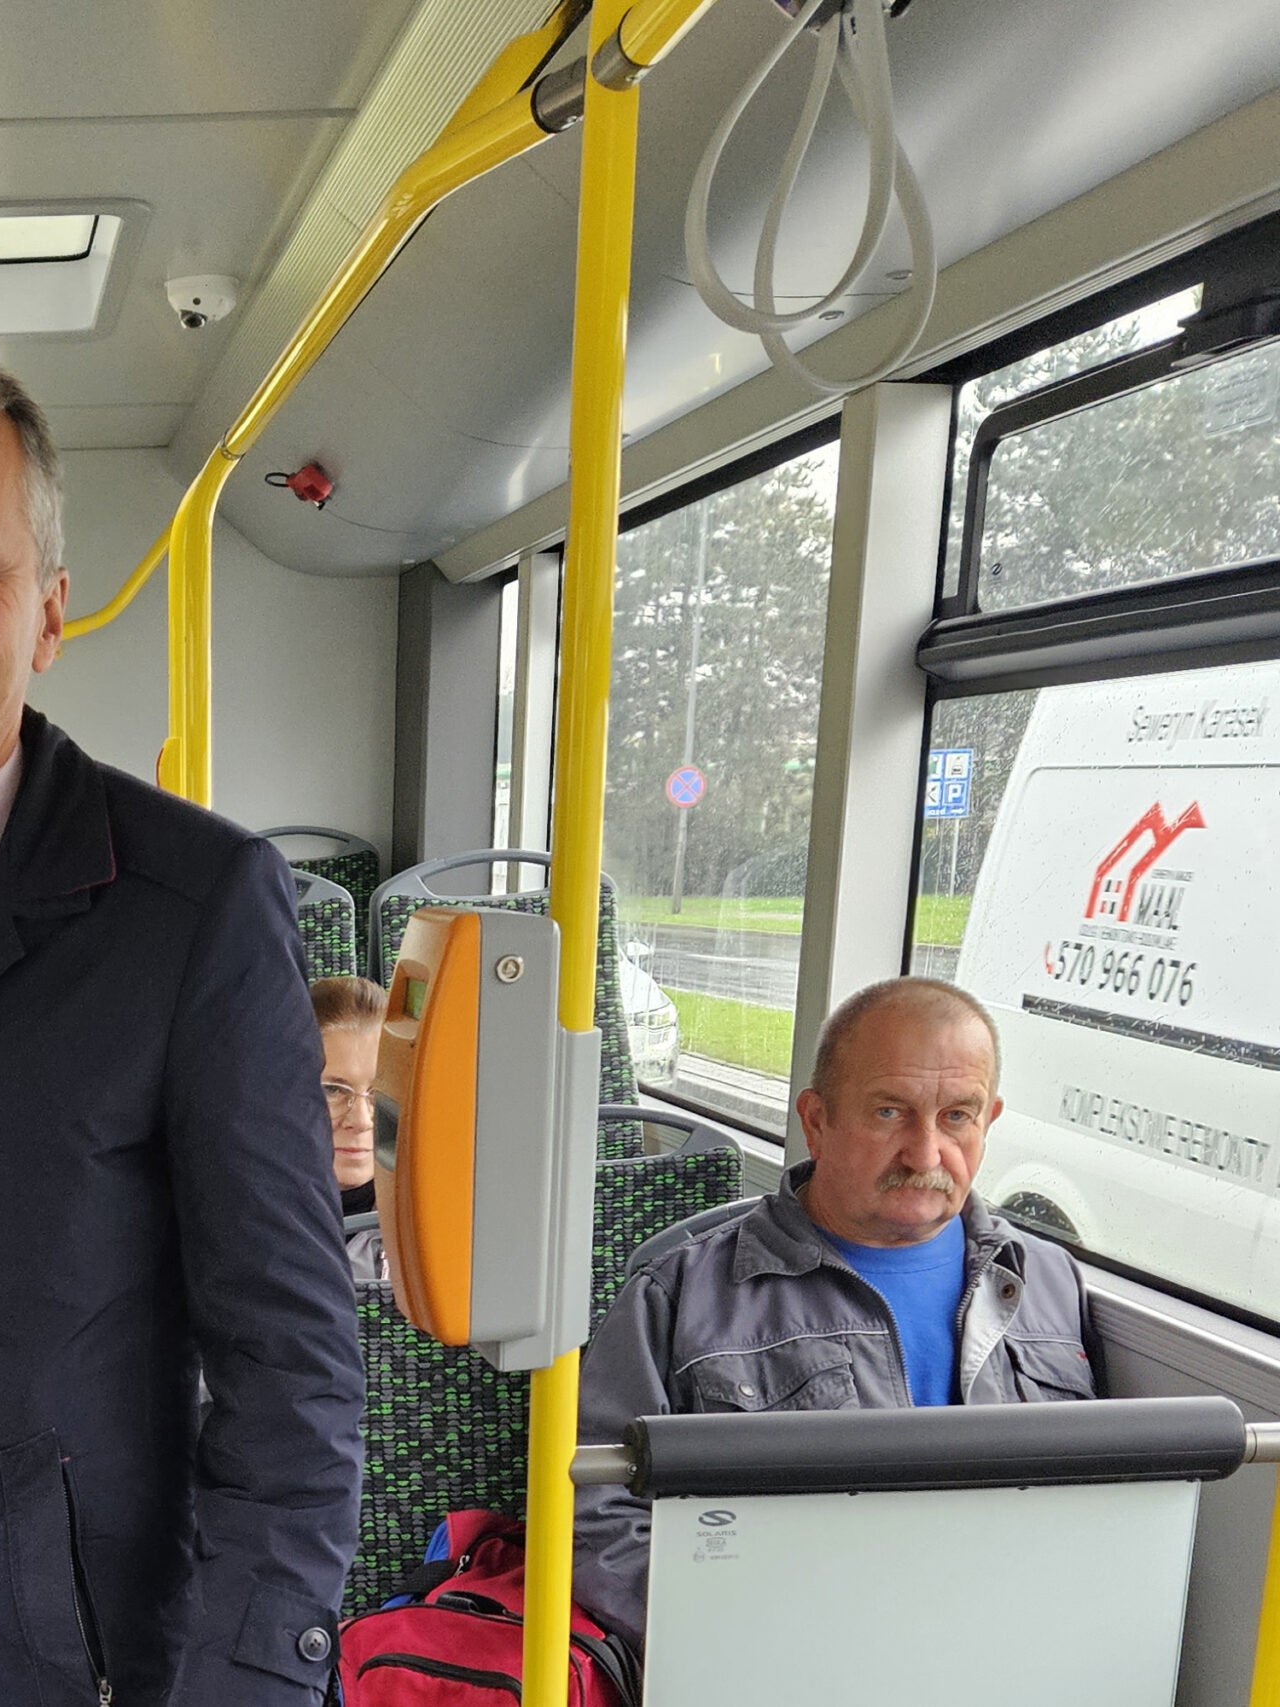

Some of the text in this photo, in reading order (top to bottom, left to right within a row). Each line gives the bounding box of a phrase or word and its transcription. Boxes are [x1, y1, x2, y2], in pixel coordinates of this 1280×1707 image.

[949, 785, 962, 802] P
[1054, 941, 1198, 1007] 570 966 076
